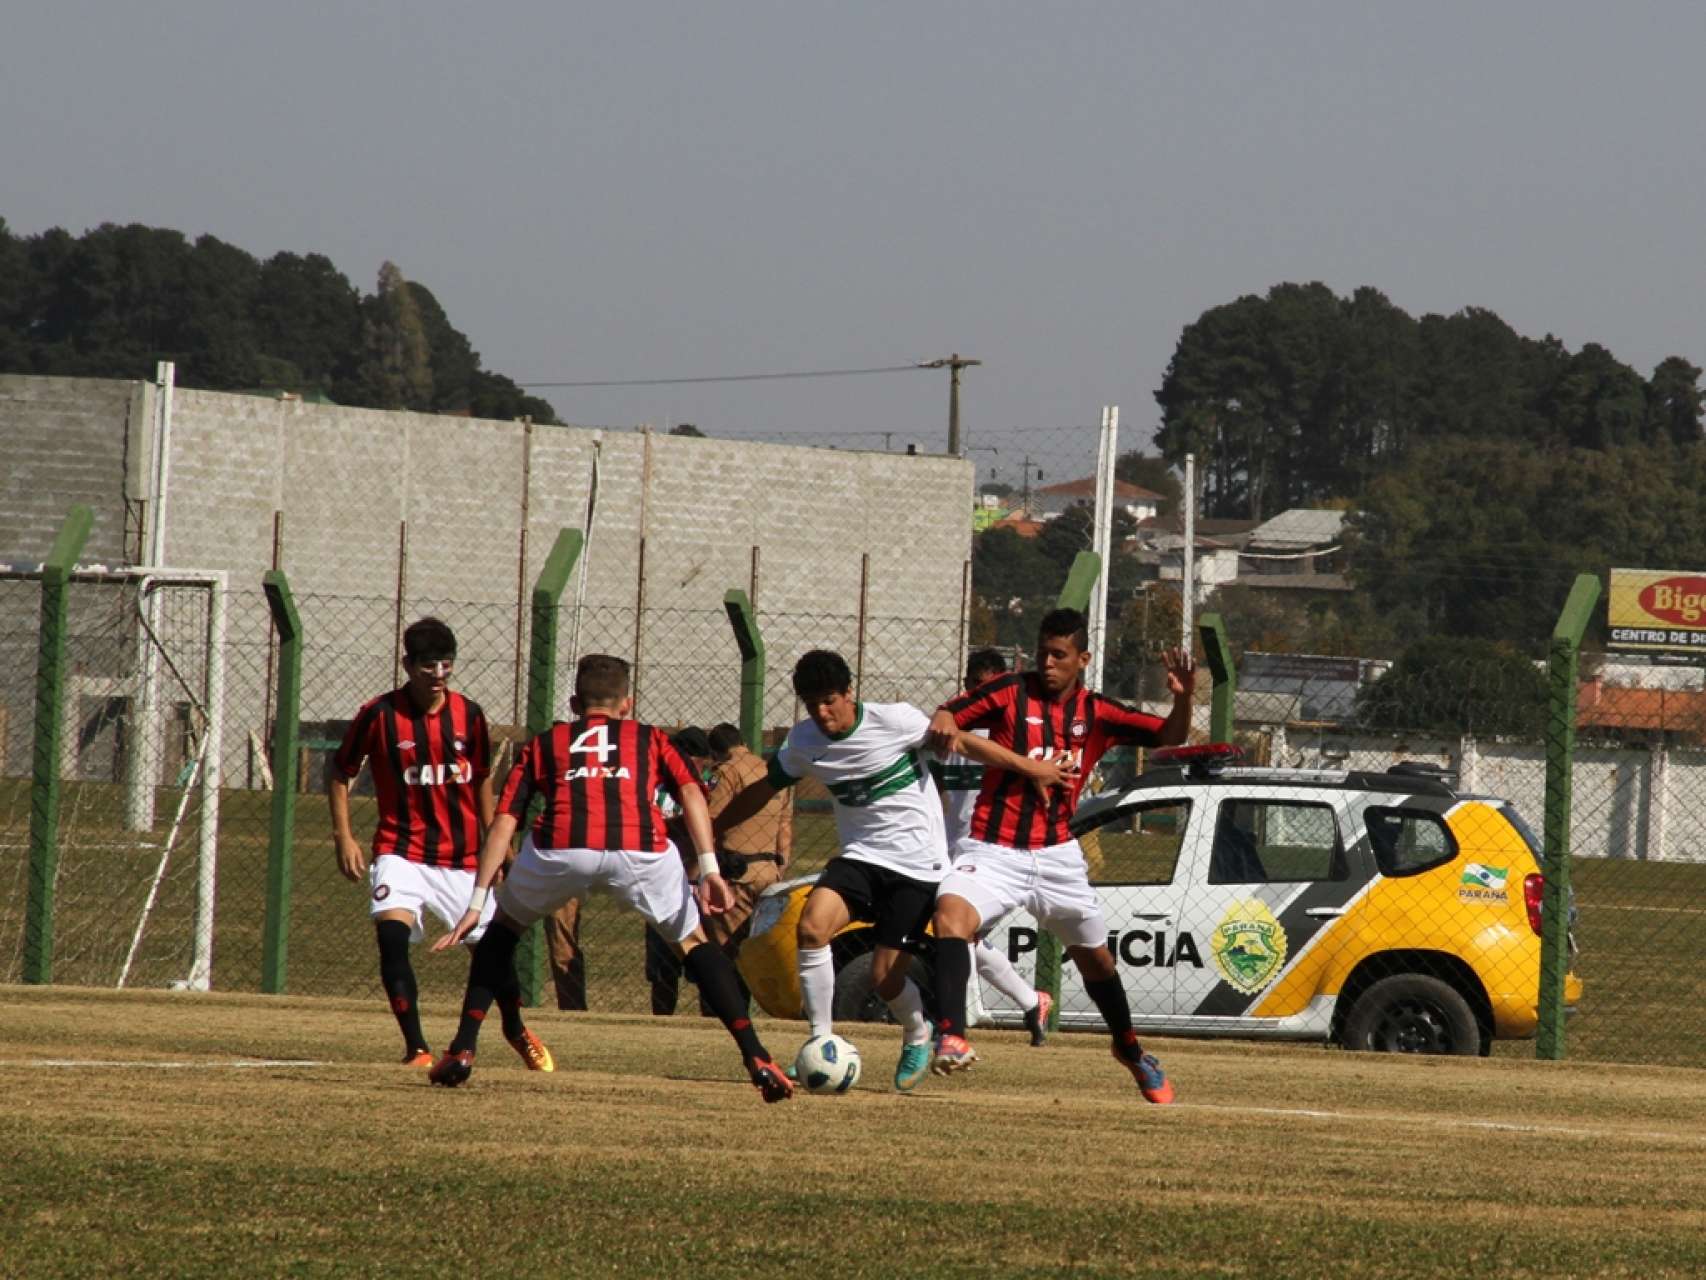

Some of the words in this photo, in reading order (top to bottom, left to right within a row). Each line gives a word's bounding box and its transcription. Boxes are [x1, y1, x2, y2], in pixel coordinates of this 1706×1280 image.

[1612, 629, 1666, 643] CENTRO
[1670, 631, 1687, 644] DE
[569, 724, 617, 763] 4
[563, 765, 631, 781] CAIXA
[1008, 926, 1204, 969] PÍCIA
